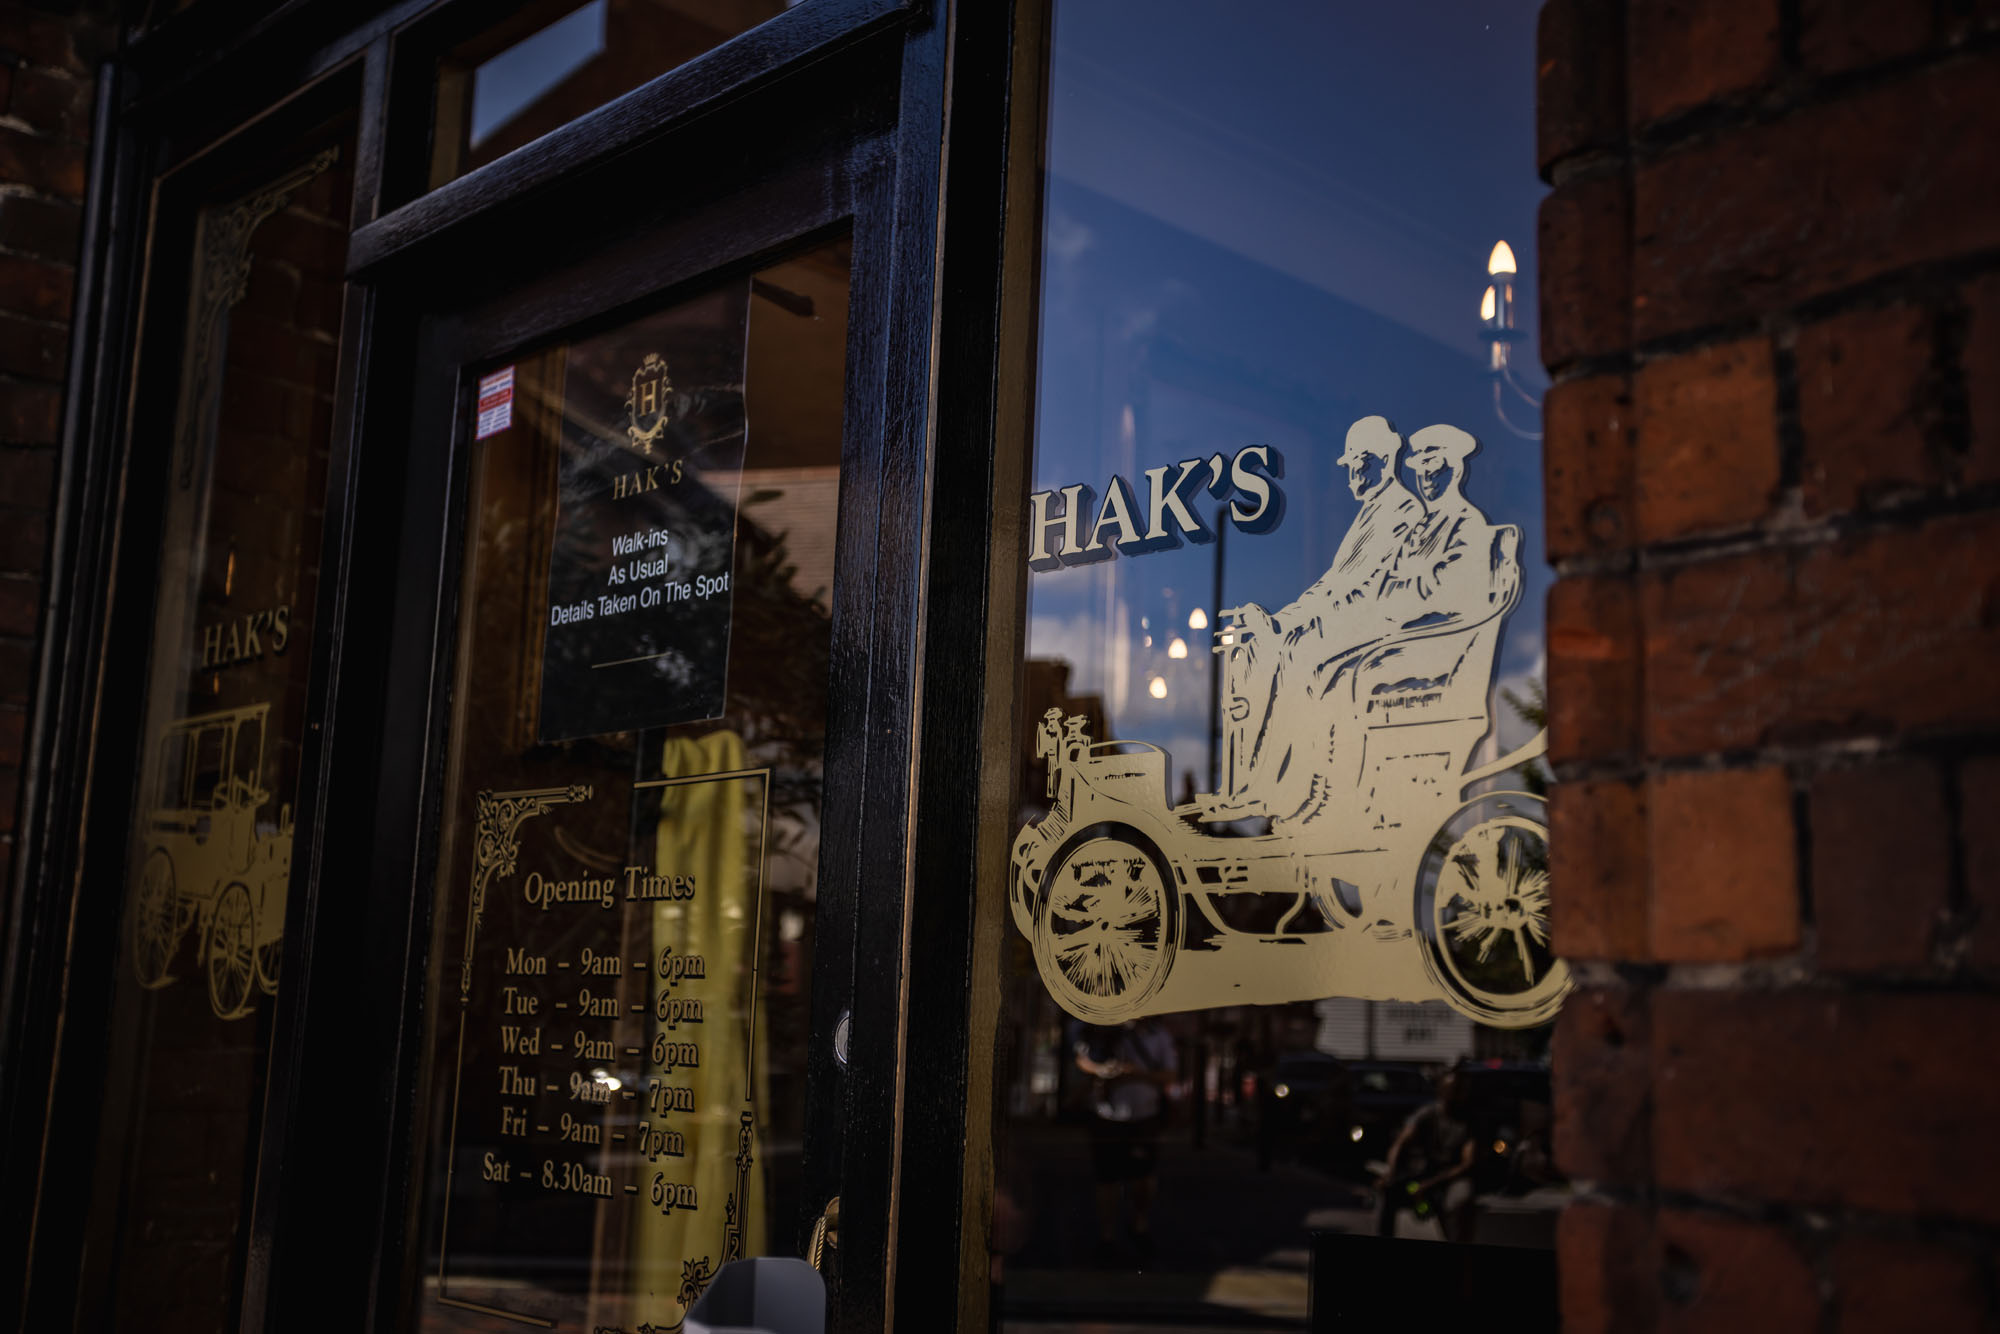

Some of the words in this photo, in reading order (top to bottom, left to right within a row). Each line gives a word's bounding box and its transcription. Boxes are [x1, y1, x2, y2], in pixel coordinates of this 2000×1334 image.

[639, 381, 657, 416] H
[612, 527, 668, 557] Walk-ins
[608, 564, 626, 586] As
[630, 554, 668, 580] Usual
[551, 602, 594, 626] Details
[598, 595, 636, 617] Taken
[640, 586, 660, 607] On
[665, 580, 690, 603] The
[695, 571, 729, 601] Spot
[524, 869, 615, 909] Opening
[624, 866, 696, 899] Times
[505, 948, 547, 976] Mon
[581, 948, 622, 977] 9am
[658, 946, 705, 986] 6pm
[503, 987, 538, 1016] Tue
[578, 988, 619, 1018] 9am
[656, 989, 703, 1030] 6pm
[501, 1026, 540, 1056] Wed
[574, 1031, 615, 1061] 9am
[652, 1033, 699, 1073] 6pm
[499, 1066, 535, 1096] Thu
[569, 1071, 611, 1104] 9am
[650, 1079, 695, 1118] 7pm
[501, 1106, 527, 1136] Fri
[560, 1112, 600, 1144] 9am
[639, 1121, 684, 1161] 7pm
[482, 1152, 510, 1184] Sat
[542, 1160, 613, 1196] 8.30am
[651, 1172, 698, 1214] 6pm
